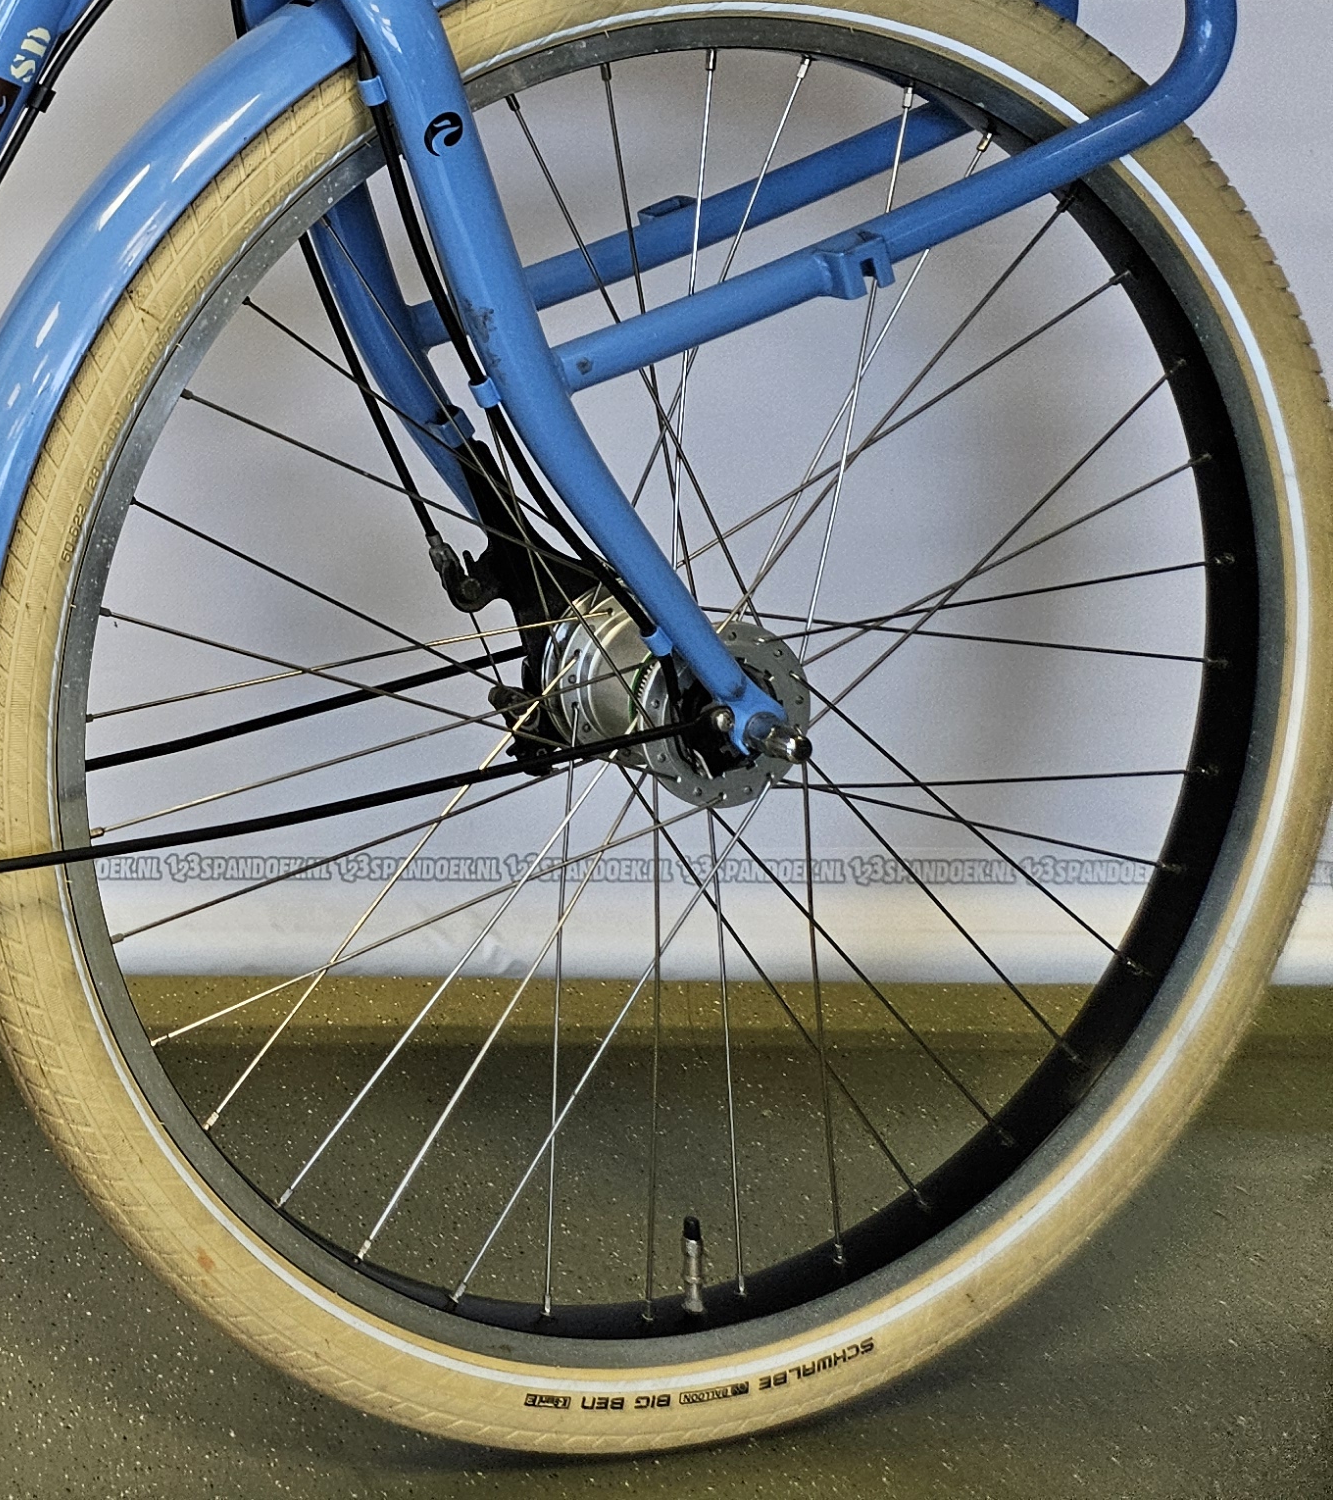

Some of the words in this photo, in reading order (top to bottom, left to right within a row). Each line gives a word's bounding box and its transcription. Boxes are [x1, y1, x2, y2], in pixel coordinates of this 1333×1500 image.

[11, 25, 53, 84] SD
[758, 1337, 875, 1391] SCHWALBE
[634, 1393, 671, 1409] BIG
